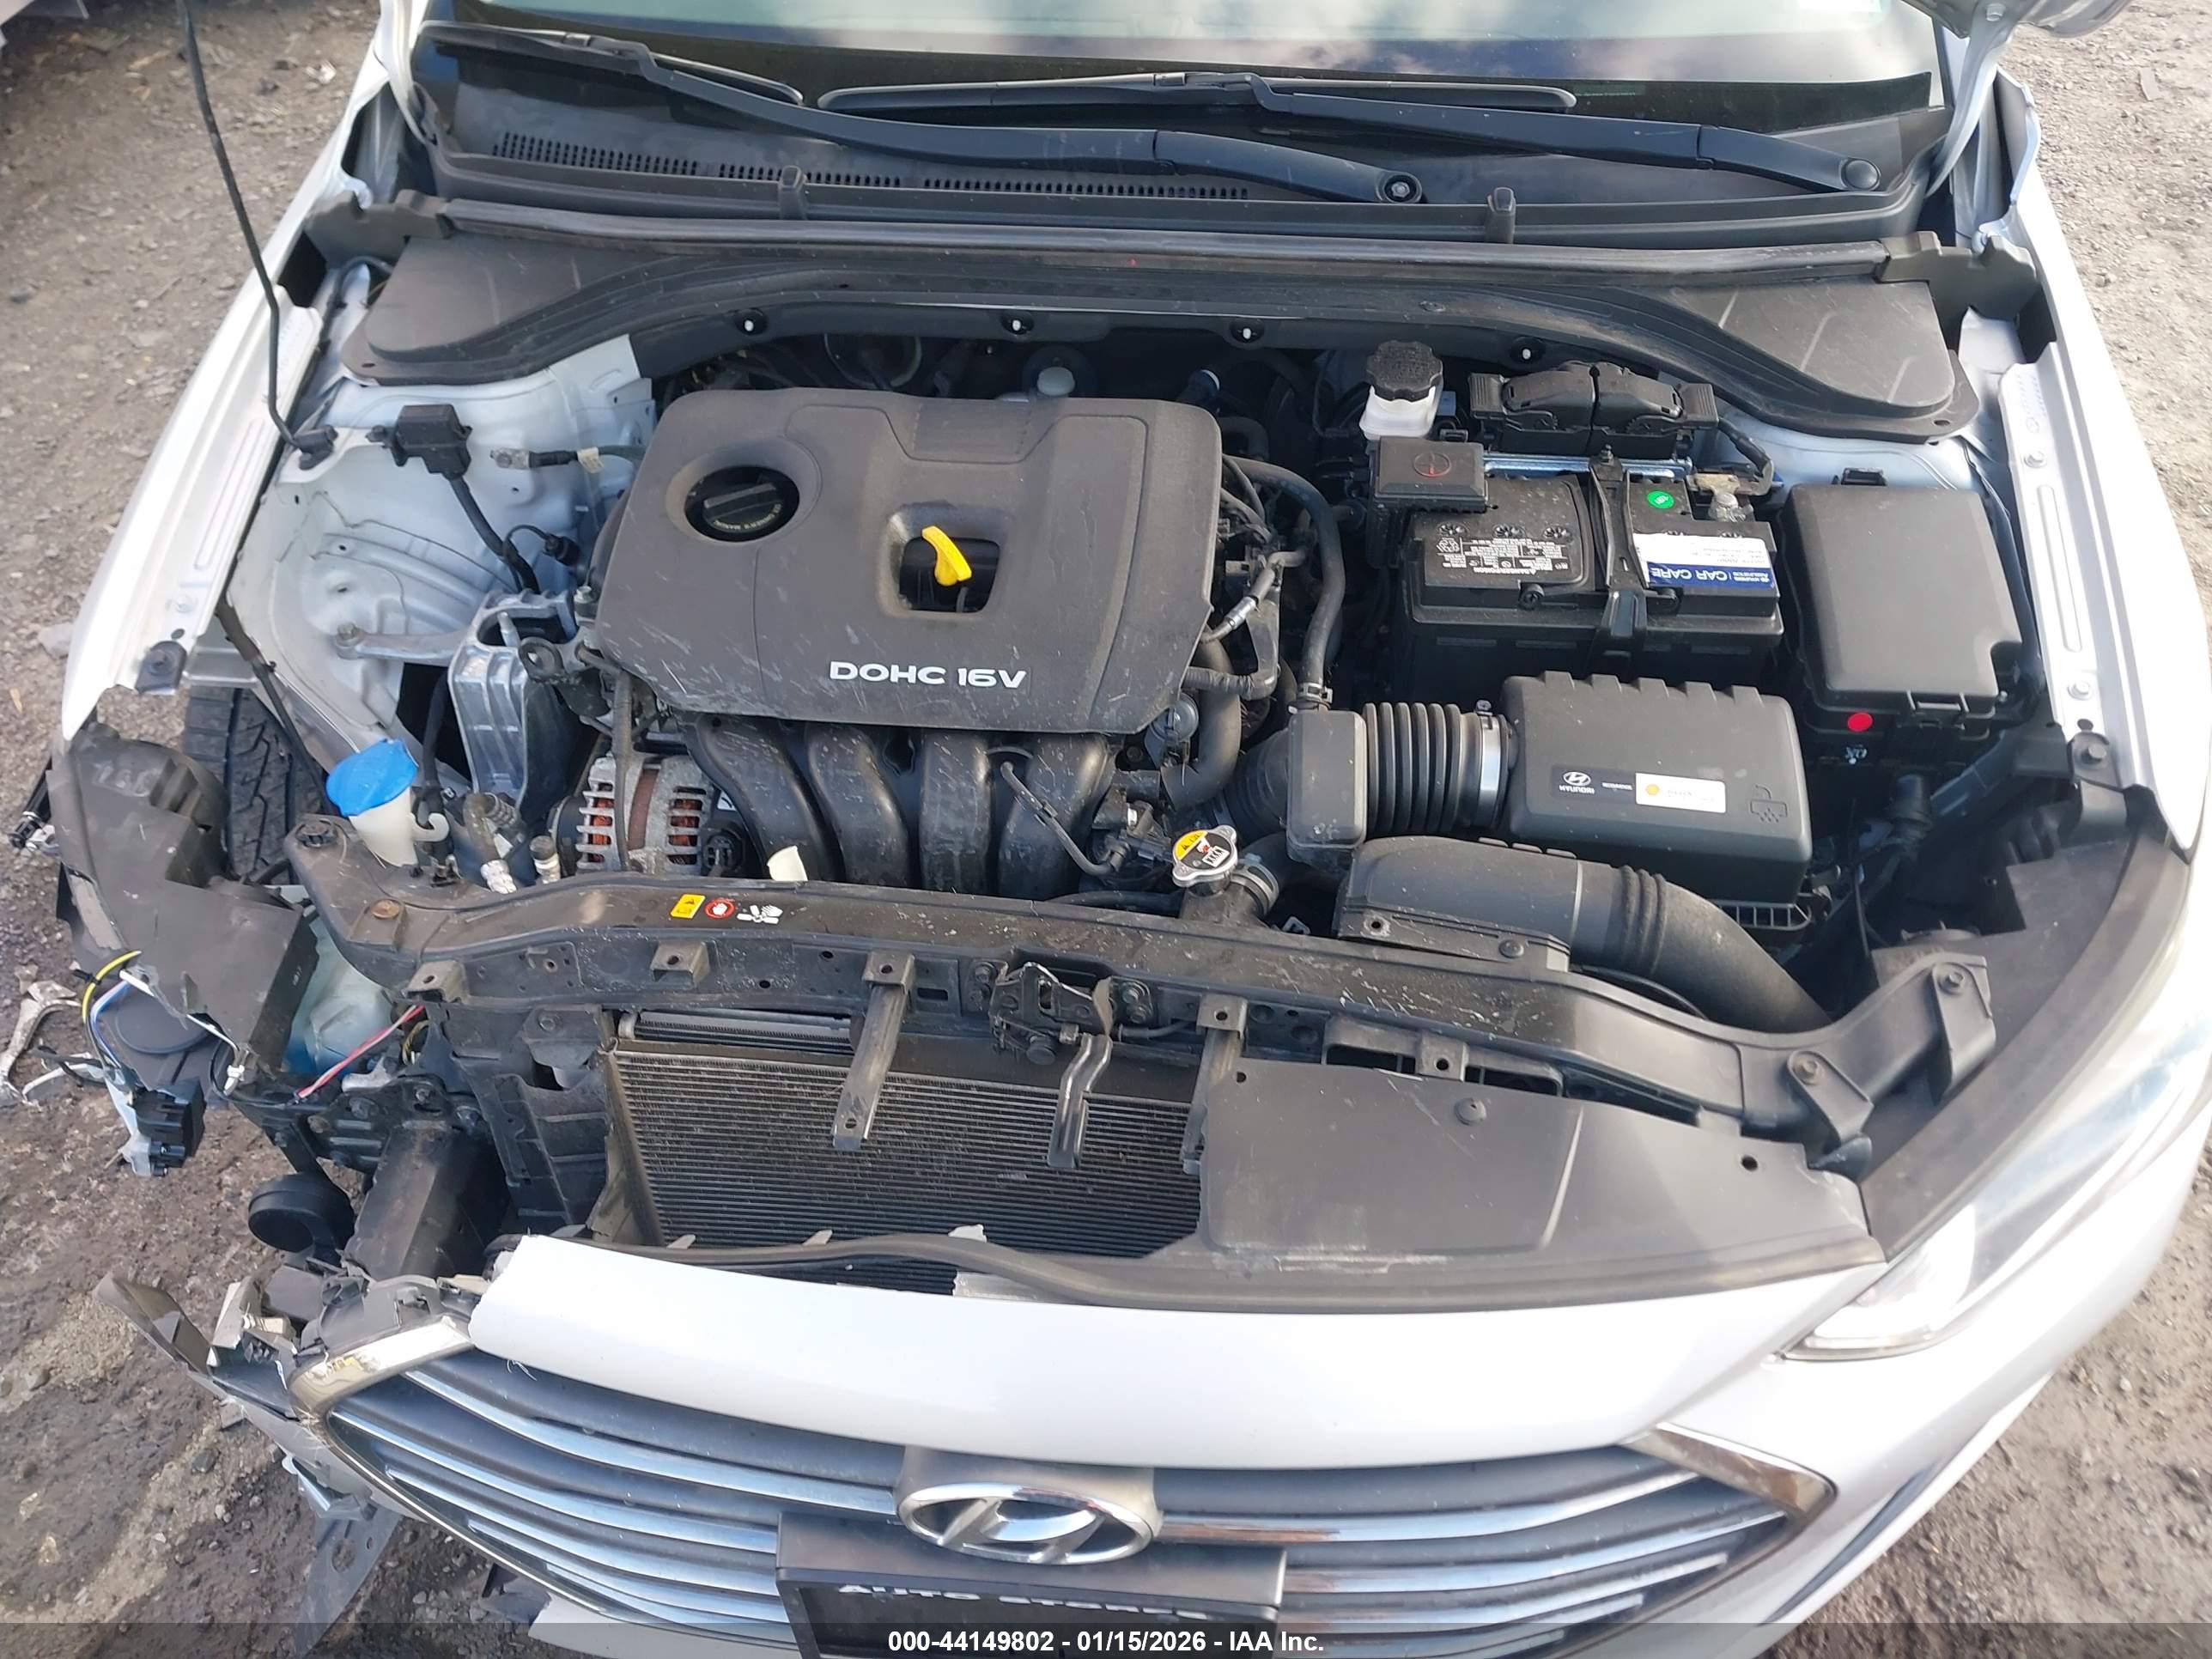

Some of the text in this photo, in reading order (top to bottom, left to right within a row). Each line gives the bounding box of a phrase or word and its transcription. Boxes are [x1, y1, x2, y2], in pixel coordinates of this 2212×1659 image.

[1650, 568, 1692, 580] CARE
[1694, 569, 1728, 581] CAR
[829, 660, 1027, 690] DOHC 16V
[1559, 784, 1595, 794] HYUNDAI
